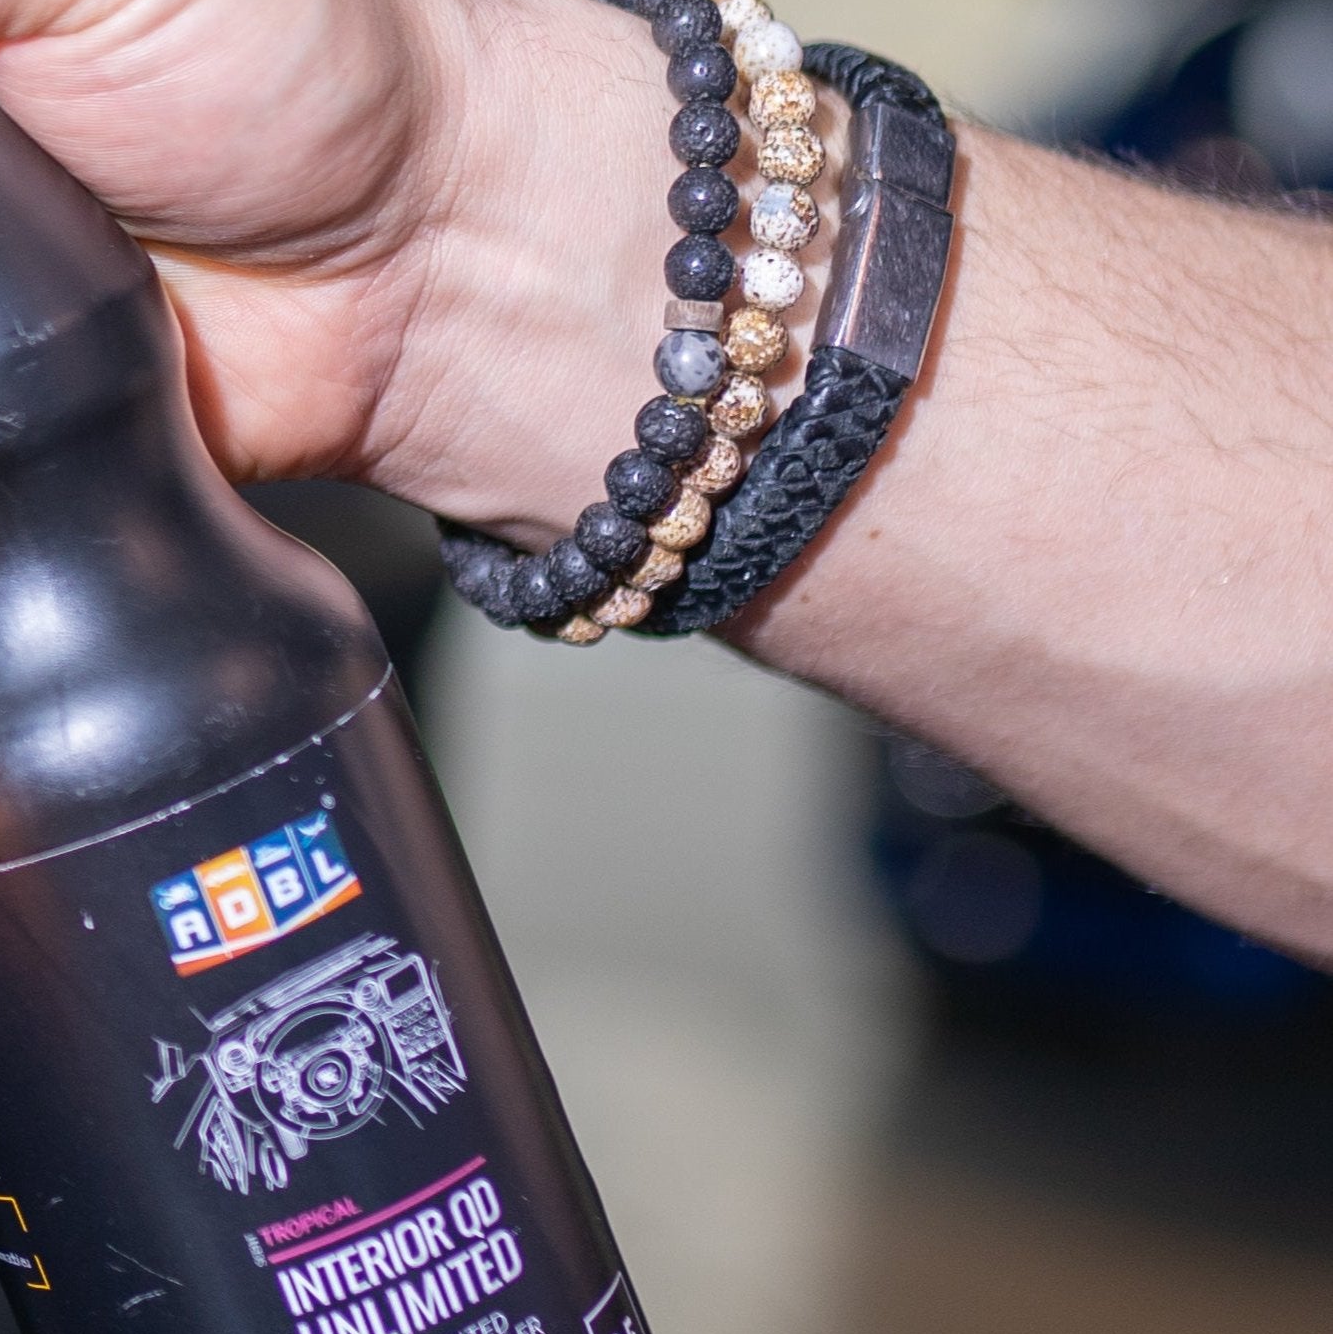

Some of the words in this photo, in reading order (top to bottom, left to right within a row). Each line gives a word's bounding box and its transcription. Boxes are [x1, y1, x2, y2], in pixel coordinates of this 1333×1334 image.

[170, 848, 346, 950] ADBL
[257, 1197, 362, 1247] TROPICAL
[276, 1207, 455, 1317] INTERIOR
[448, 1177, 502, 1240] QD
